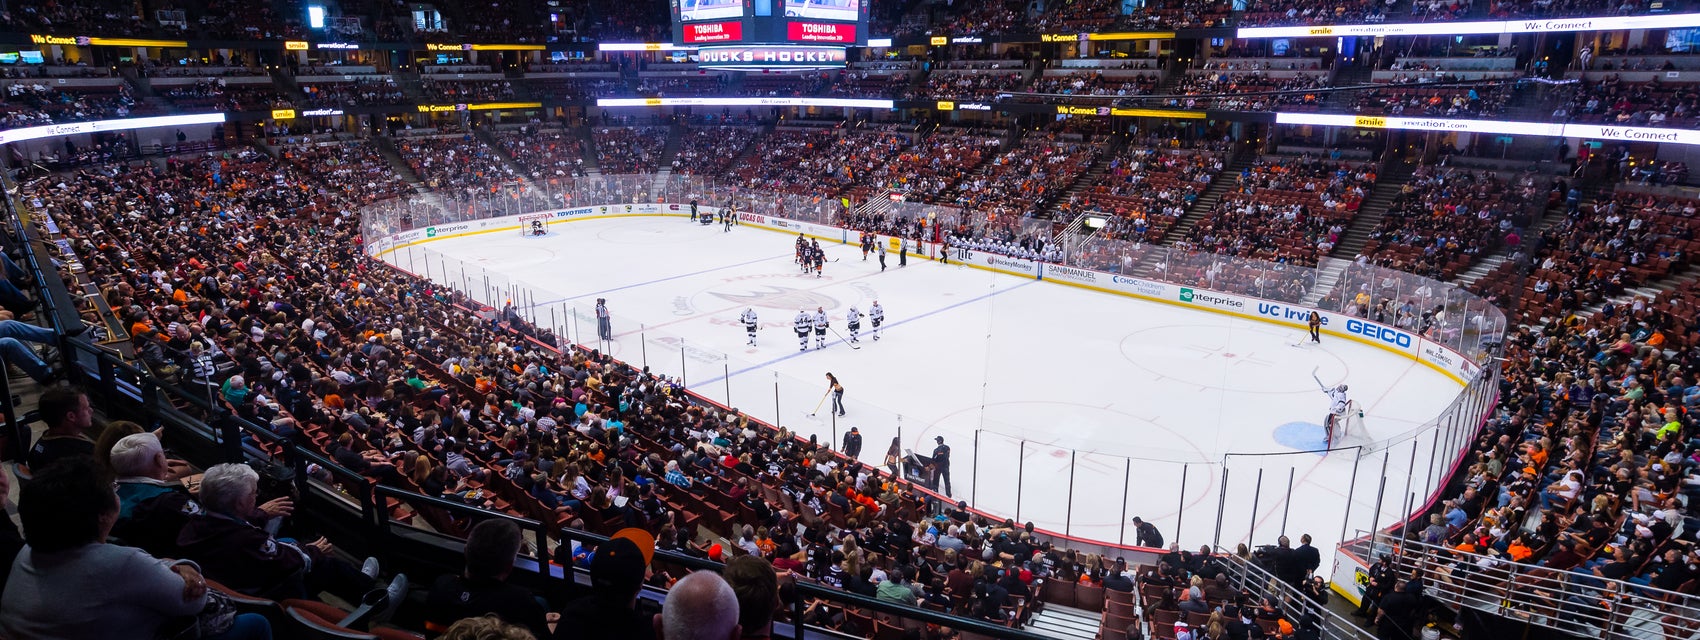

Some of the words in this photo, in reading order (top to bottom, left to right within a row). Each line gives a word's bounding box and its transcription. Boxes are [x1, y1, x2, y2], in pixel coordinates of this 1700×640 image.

[694, 24, 723, 34] TOSHIBA
[802, 24, 836, 33] TOSHIBA
[1525, 22, 1542, 30] We
[1545, 21, 1592, 30] Connect
[31, 34, 46, 44] We
[47, 35, 76, 45] Connect
[703, 52, 754, 62] DUCKS
[764, 51, 835, 62] HOCKEY
[1057, 106, 1069, 114] We
[1069, 107, 1097, 115] Connect
[1358, 118, 1383, 126] smile
[56, 125, 80, 134] Connect
[1601, 128, 1620, 137] We
[1624, 130, 1678, 141] Connect
[740, 213, 756, 222] LUCAS
[757, 215, 765, 224] OIL
[428, 224, 468, 236] enterprise
[995, 257, 1033, 271] HockeyMonkey
[1048, 265, 1063, 273] SAN
[1067, 268, 1096, 280] MANUEL
[1120, 277, 1138, 286] CHOC
[1183, 291, 1243, 308] enterprise
[1258, 303, 1280, 316] UC
[1285, 307, 1329, 326] Irvie
[1346, 319, 1411, 348] GEICO
